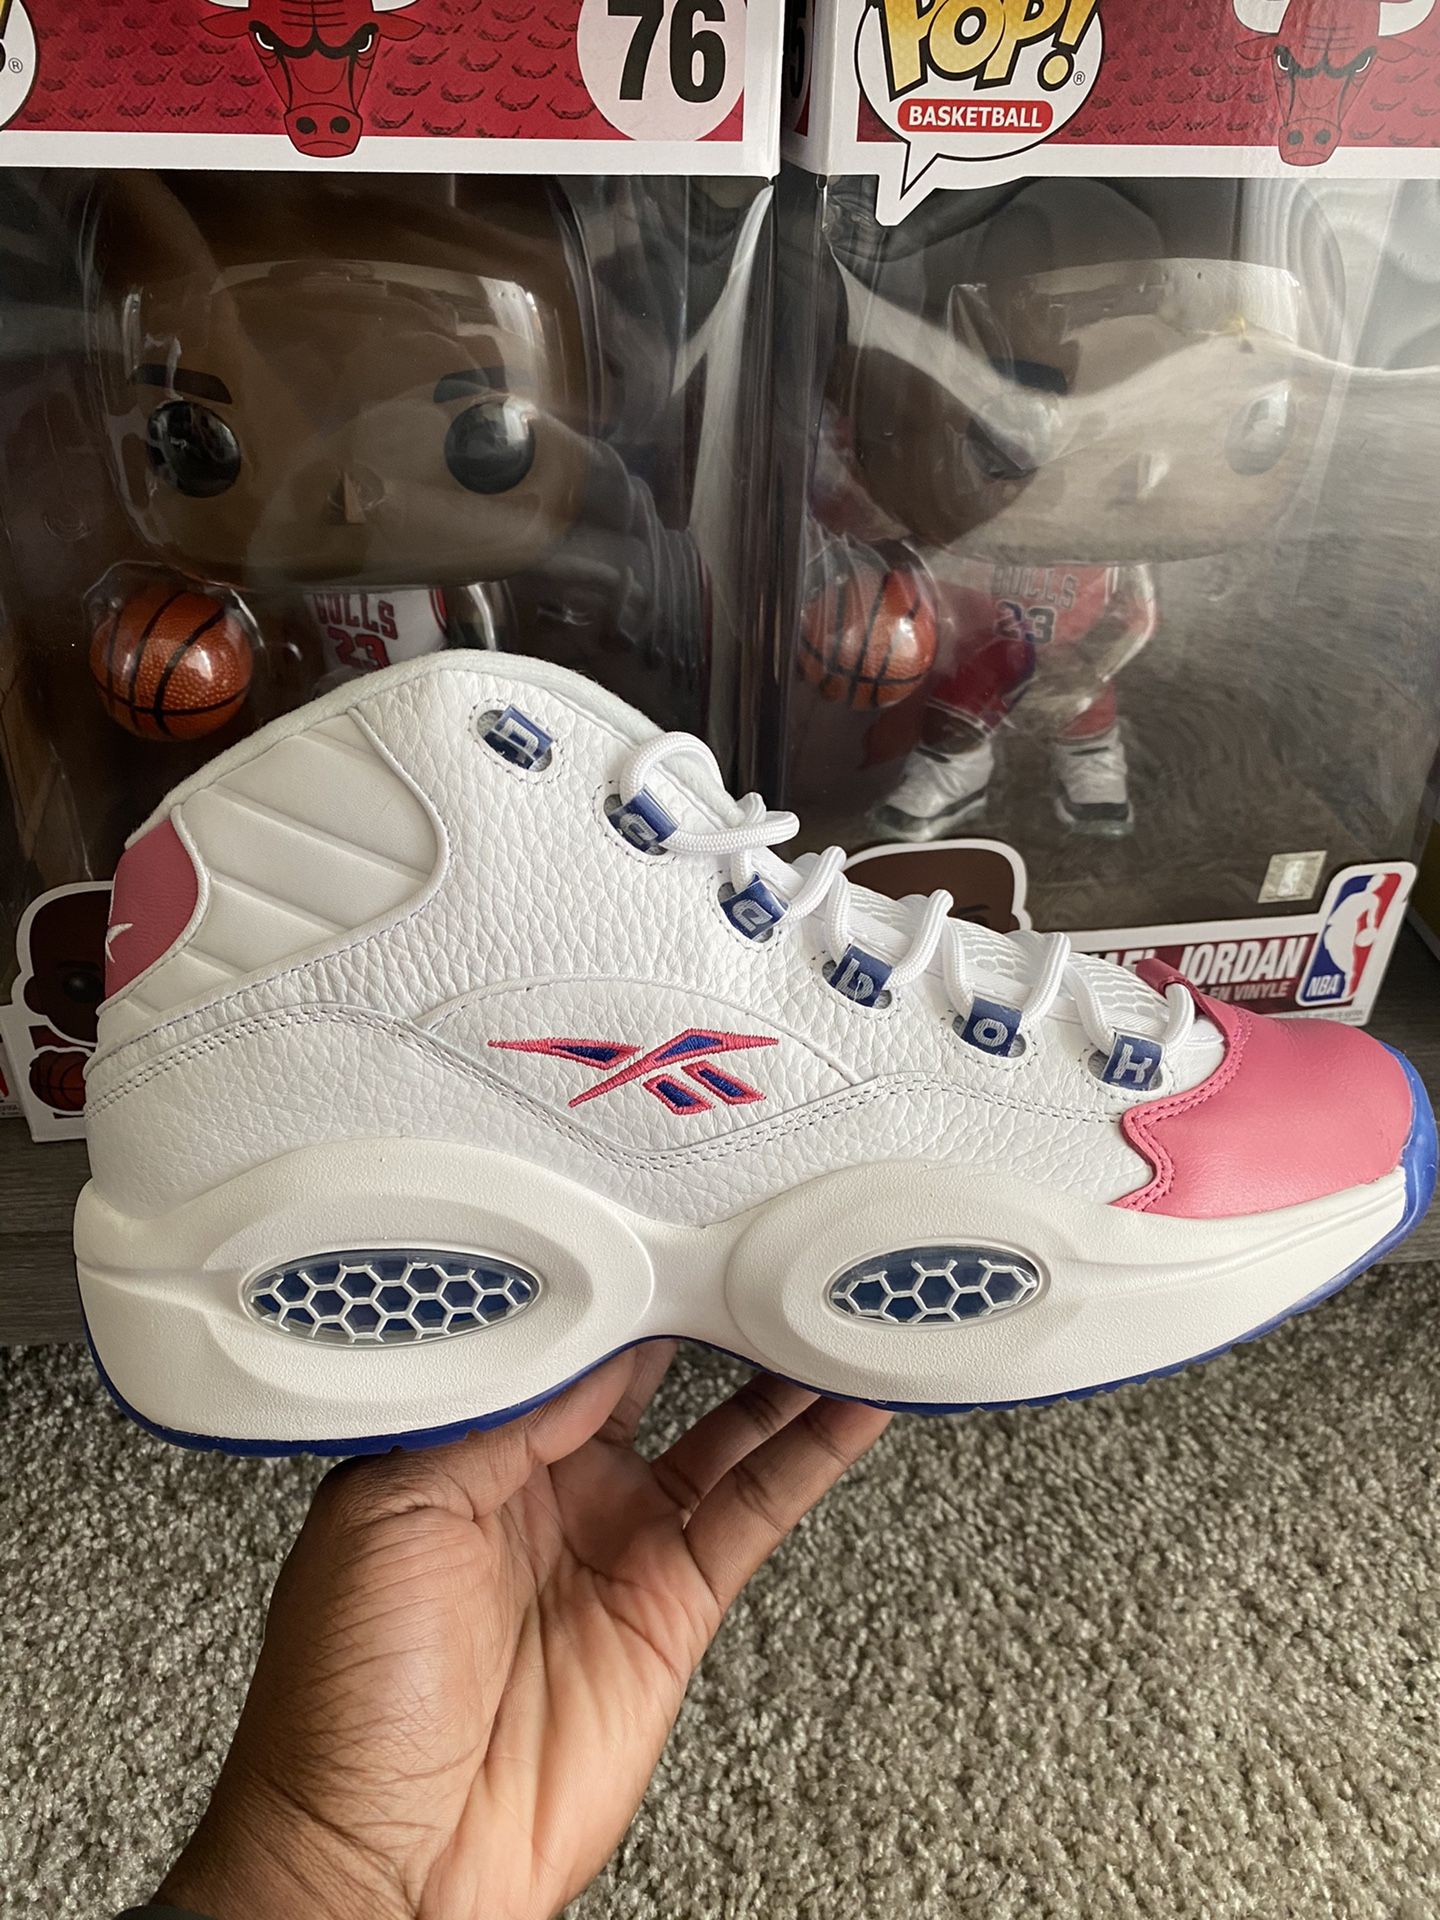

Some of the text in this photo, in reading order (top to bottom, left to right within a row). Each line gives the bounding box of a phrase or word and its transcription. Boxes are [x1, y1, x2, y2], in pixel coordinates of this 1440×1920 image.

[607, 0, 726, 103] 76
[876, 0, 1100, 102] POP!
[908, 105, 1043, 128] BASKETBALL
[994, 599, 1056, 643] 23
[326, 625, 392, 671] 23
[1178, 936, 1307, 986] JORDAN
[1234, 981, 1290, 1000] VINYLE
[1305, 974, 1341, 997] NBA
